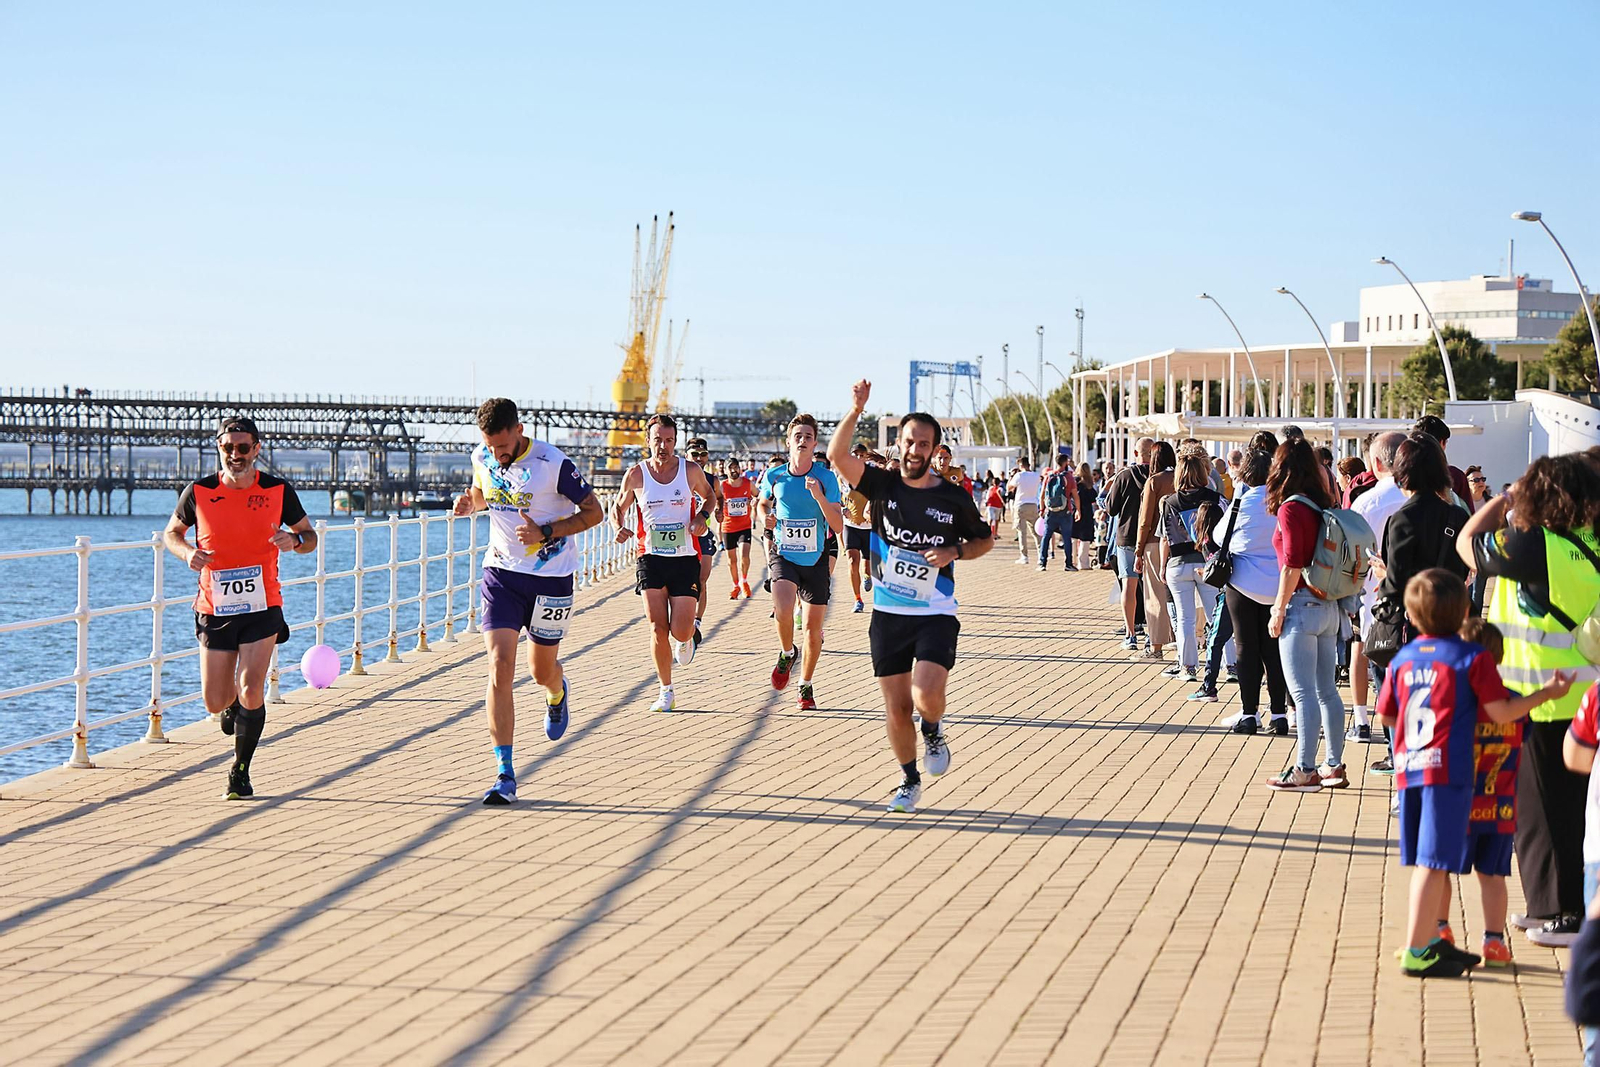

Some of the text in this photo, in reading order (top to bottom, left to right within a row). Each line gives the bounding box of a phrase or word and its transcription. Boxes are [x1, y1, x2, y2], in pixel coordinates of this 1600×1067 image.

[659, 531, 677, 541] 76
[786, 528, 811, 538] 310
[894, 561, 929, 581] 652
[220, 579, 256, 595] 705
[541, 607, 571, 620] 287
[1404, 668, 1438, 686] GAVI
[1404, 687, 1437, 750] 6
[1470, 803, 1498, 819] cef
